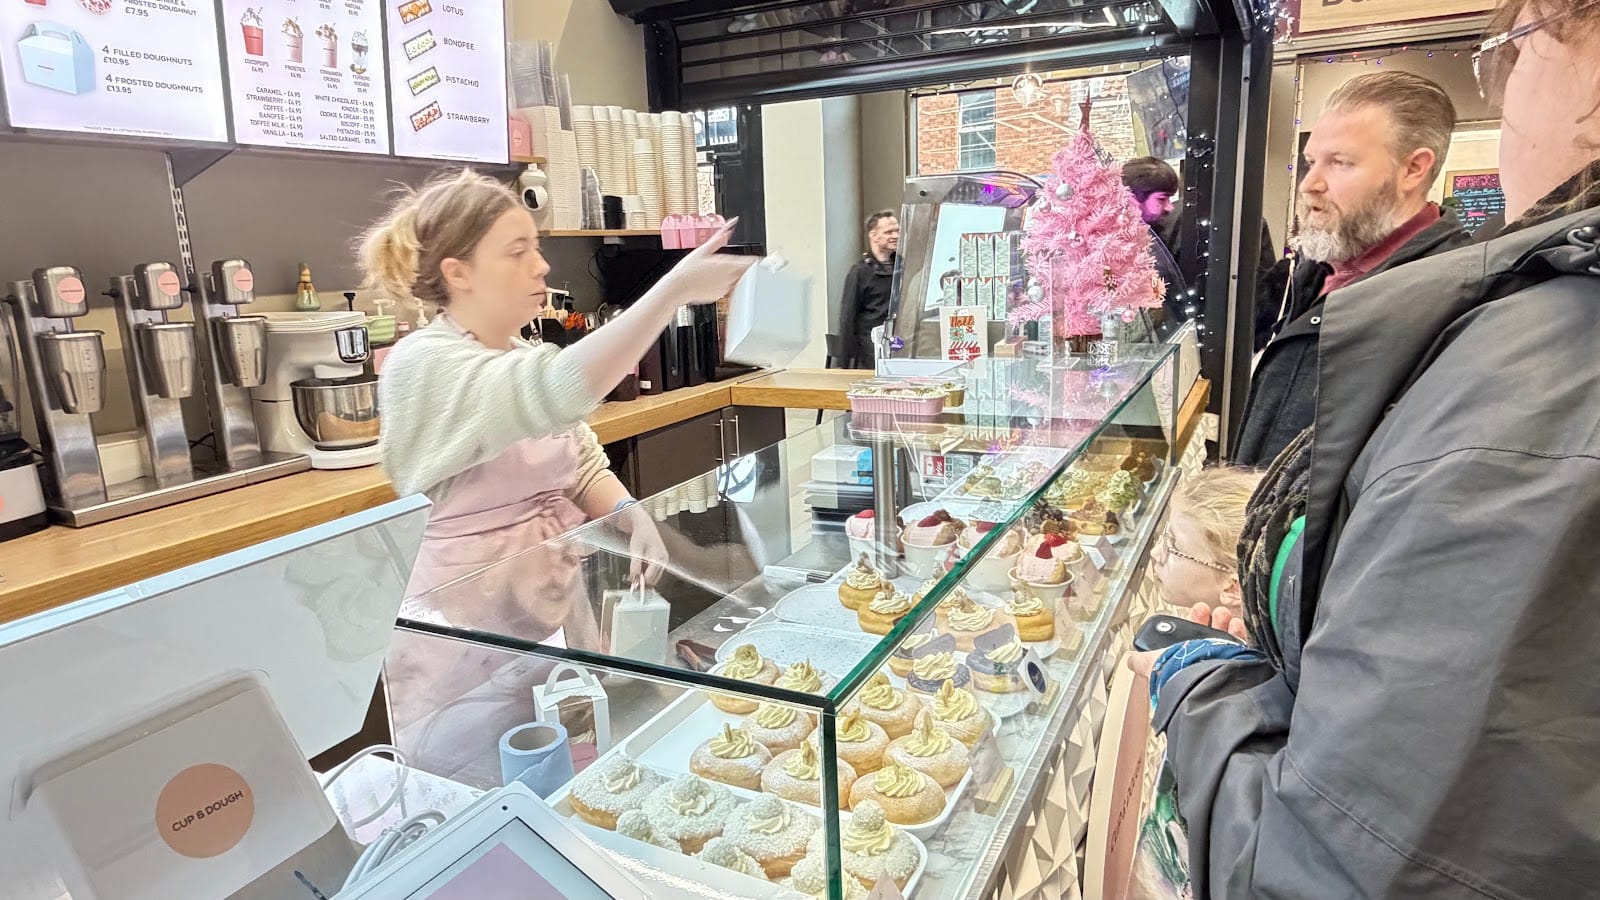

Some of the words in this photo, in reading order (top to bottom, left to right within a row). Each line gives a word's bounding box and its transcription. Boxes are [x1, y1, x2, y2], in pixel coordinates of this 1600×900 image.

[124, 0, 158, 8] ROSTED
[158, 4, 196, 16] DOUGHNUT
[126, 7, 148, 16] £7.95
[442, 4, 464, 16] LOTUS
[102, 45, 110, 54] 4
[114, 48, 142, 58] FILLED
[144, 53, 192, 66] DOUGHNUTS
[104, 56, 130, 66] £10.95
[106, 74, 112, 82] 4
[115, 77, 154, 88] FROSTED
[156, 82, 204, 94] DOUGHNUTS
[446, 76, 479, 88] PISTACHIO
[106, 85, 132, 94] £13.95
[256, 86, 282, 96] CARAMEL
[246, 94, 283, 104] STRAWBERRY
[332, 96, 358, 106] CHOCOLATE
[320, 110, 338, 118] COOKIE
[446, 113, 490, 124] STRAWBERRY
[262, 129, 286, 137] VANILLA
[172, 815, 194, 832] CUP
[196, 810, 205, 820] &
[205, 790, 244, 815] DOUGH
